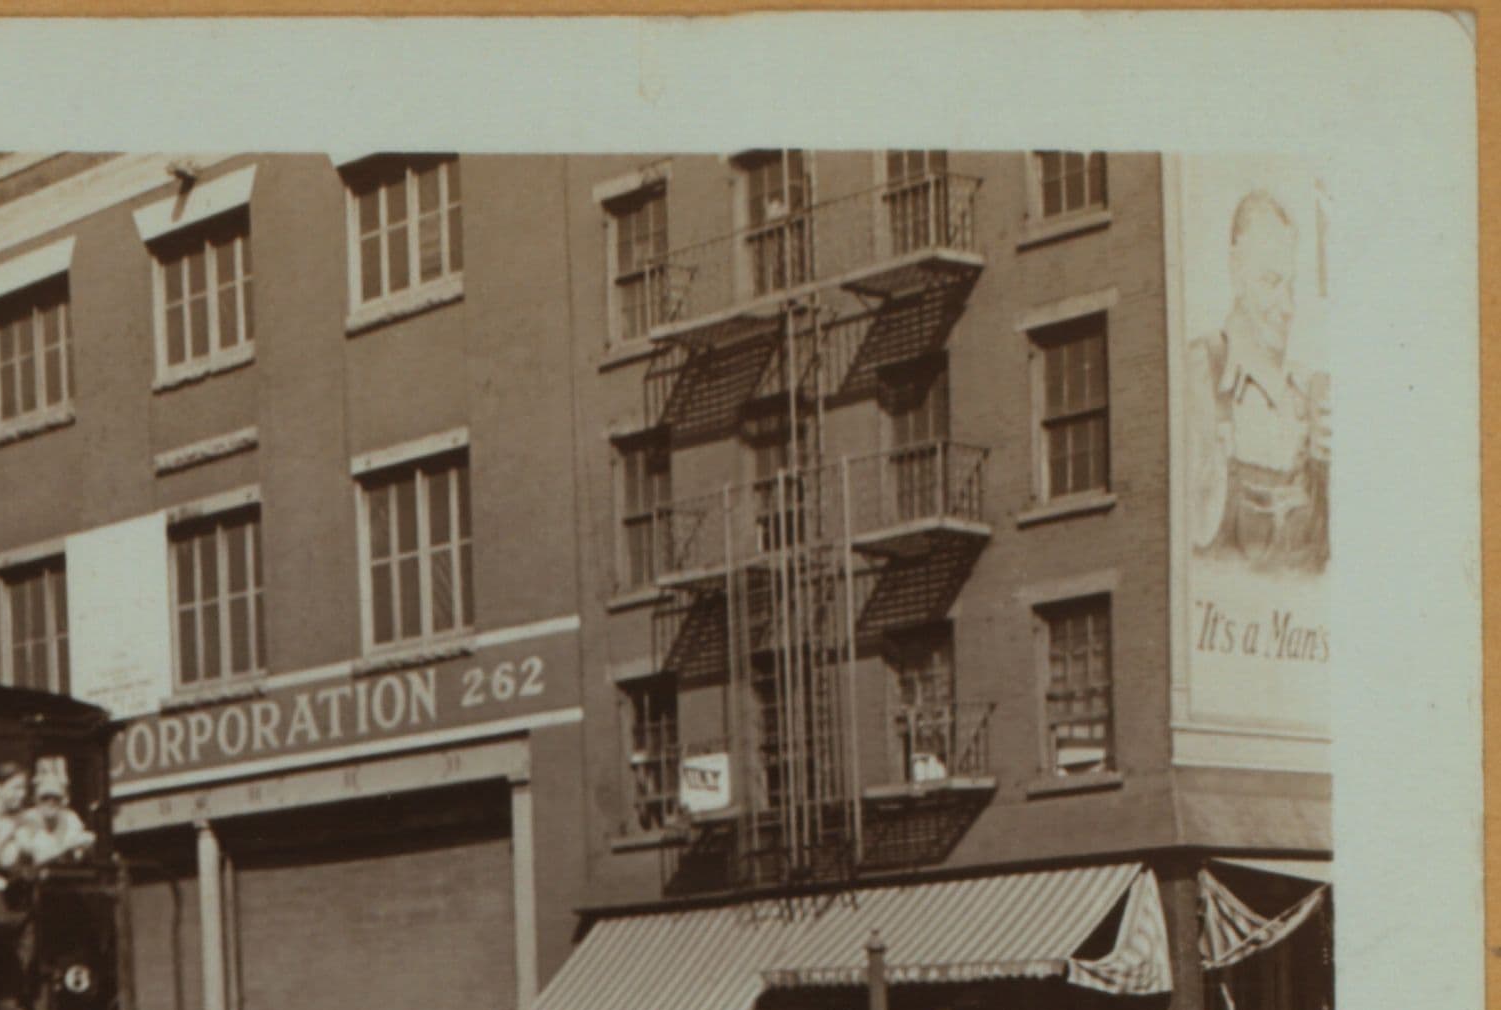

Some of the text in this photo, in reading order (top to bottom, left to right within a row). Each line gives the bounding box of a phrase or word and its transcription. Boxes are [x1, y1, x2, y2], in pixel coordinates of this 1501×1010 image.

[1242, 621, 1260, 655] a
[1263, 608, 1330, 665] Man's
[461, 656, 545, 708] 262
